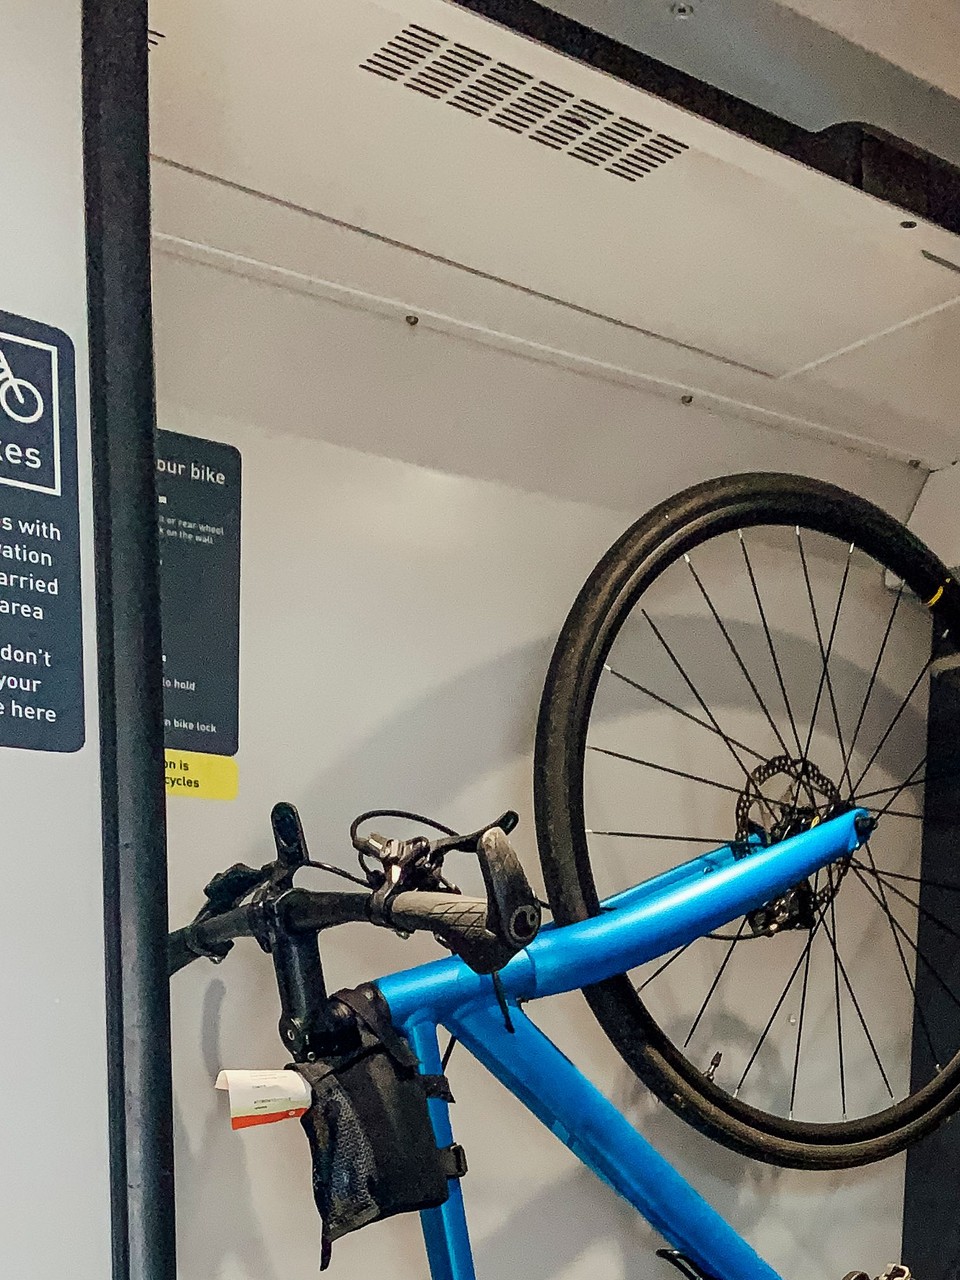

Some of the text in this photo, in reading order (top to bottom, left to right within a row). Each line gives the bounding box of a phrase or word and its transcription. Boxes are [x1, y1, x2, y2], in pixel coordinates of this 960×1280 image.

[0, 441, 41, 469] es
[191, 462, 226, 485] bike
[18, 519, 61, 541] with
[167, 517, 176, 525] or
[178, 519, 196, 529] rear
[198, 523, 224, 536] wheel
[179, 530, 194, 540] the
[195, 535, 214, 545] wall
[0, 543, 52, 567] ation
[0, 600, 43, 620] area
[0, 643, 52, 667] don't
[174, 679, 195, 691] hold
[11, 699, 57, 722] here
[173, 718, 194, 731] bike
[196, 721, 217, 733] lock
[179, 760, 189, 771] is
